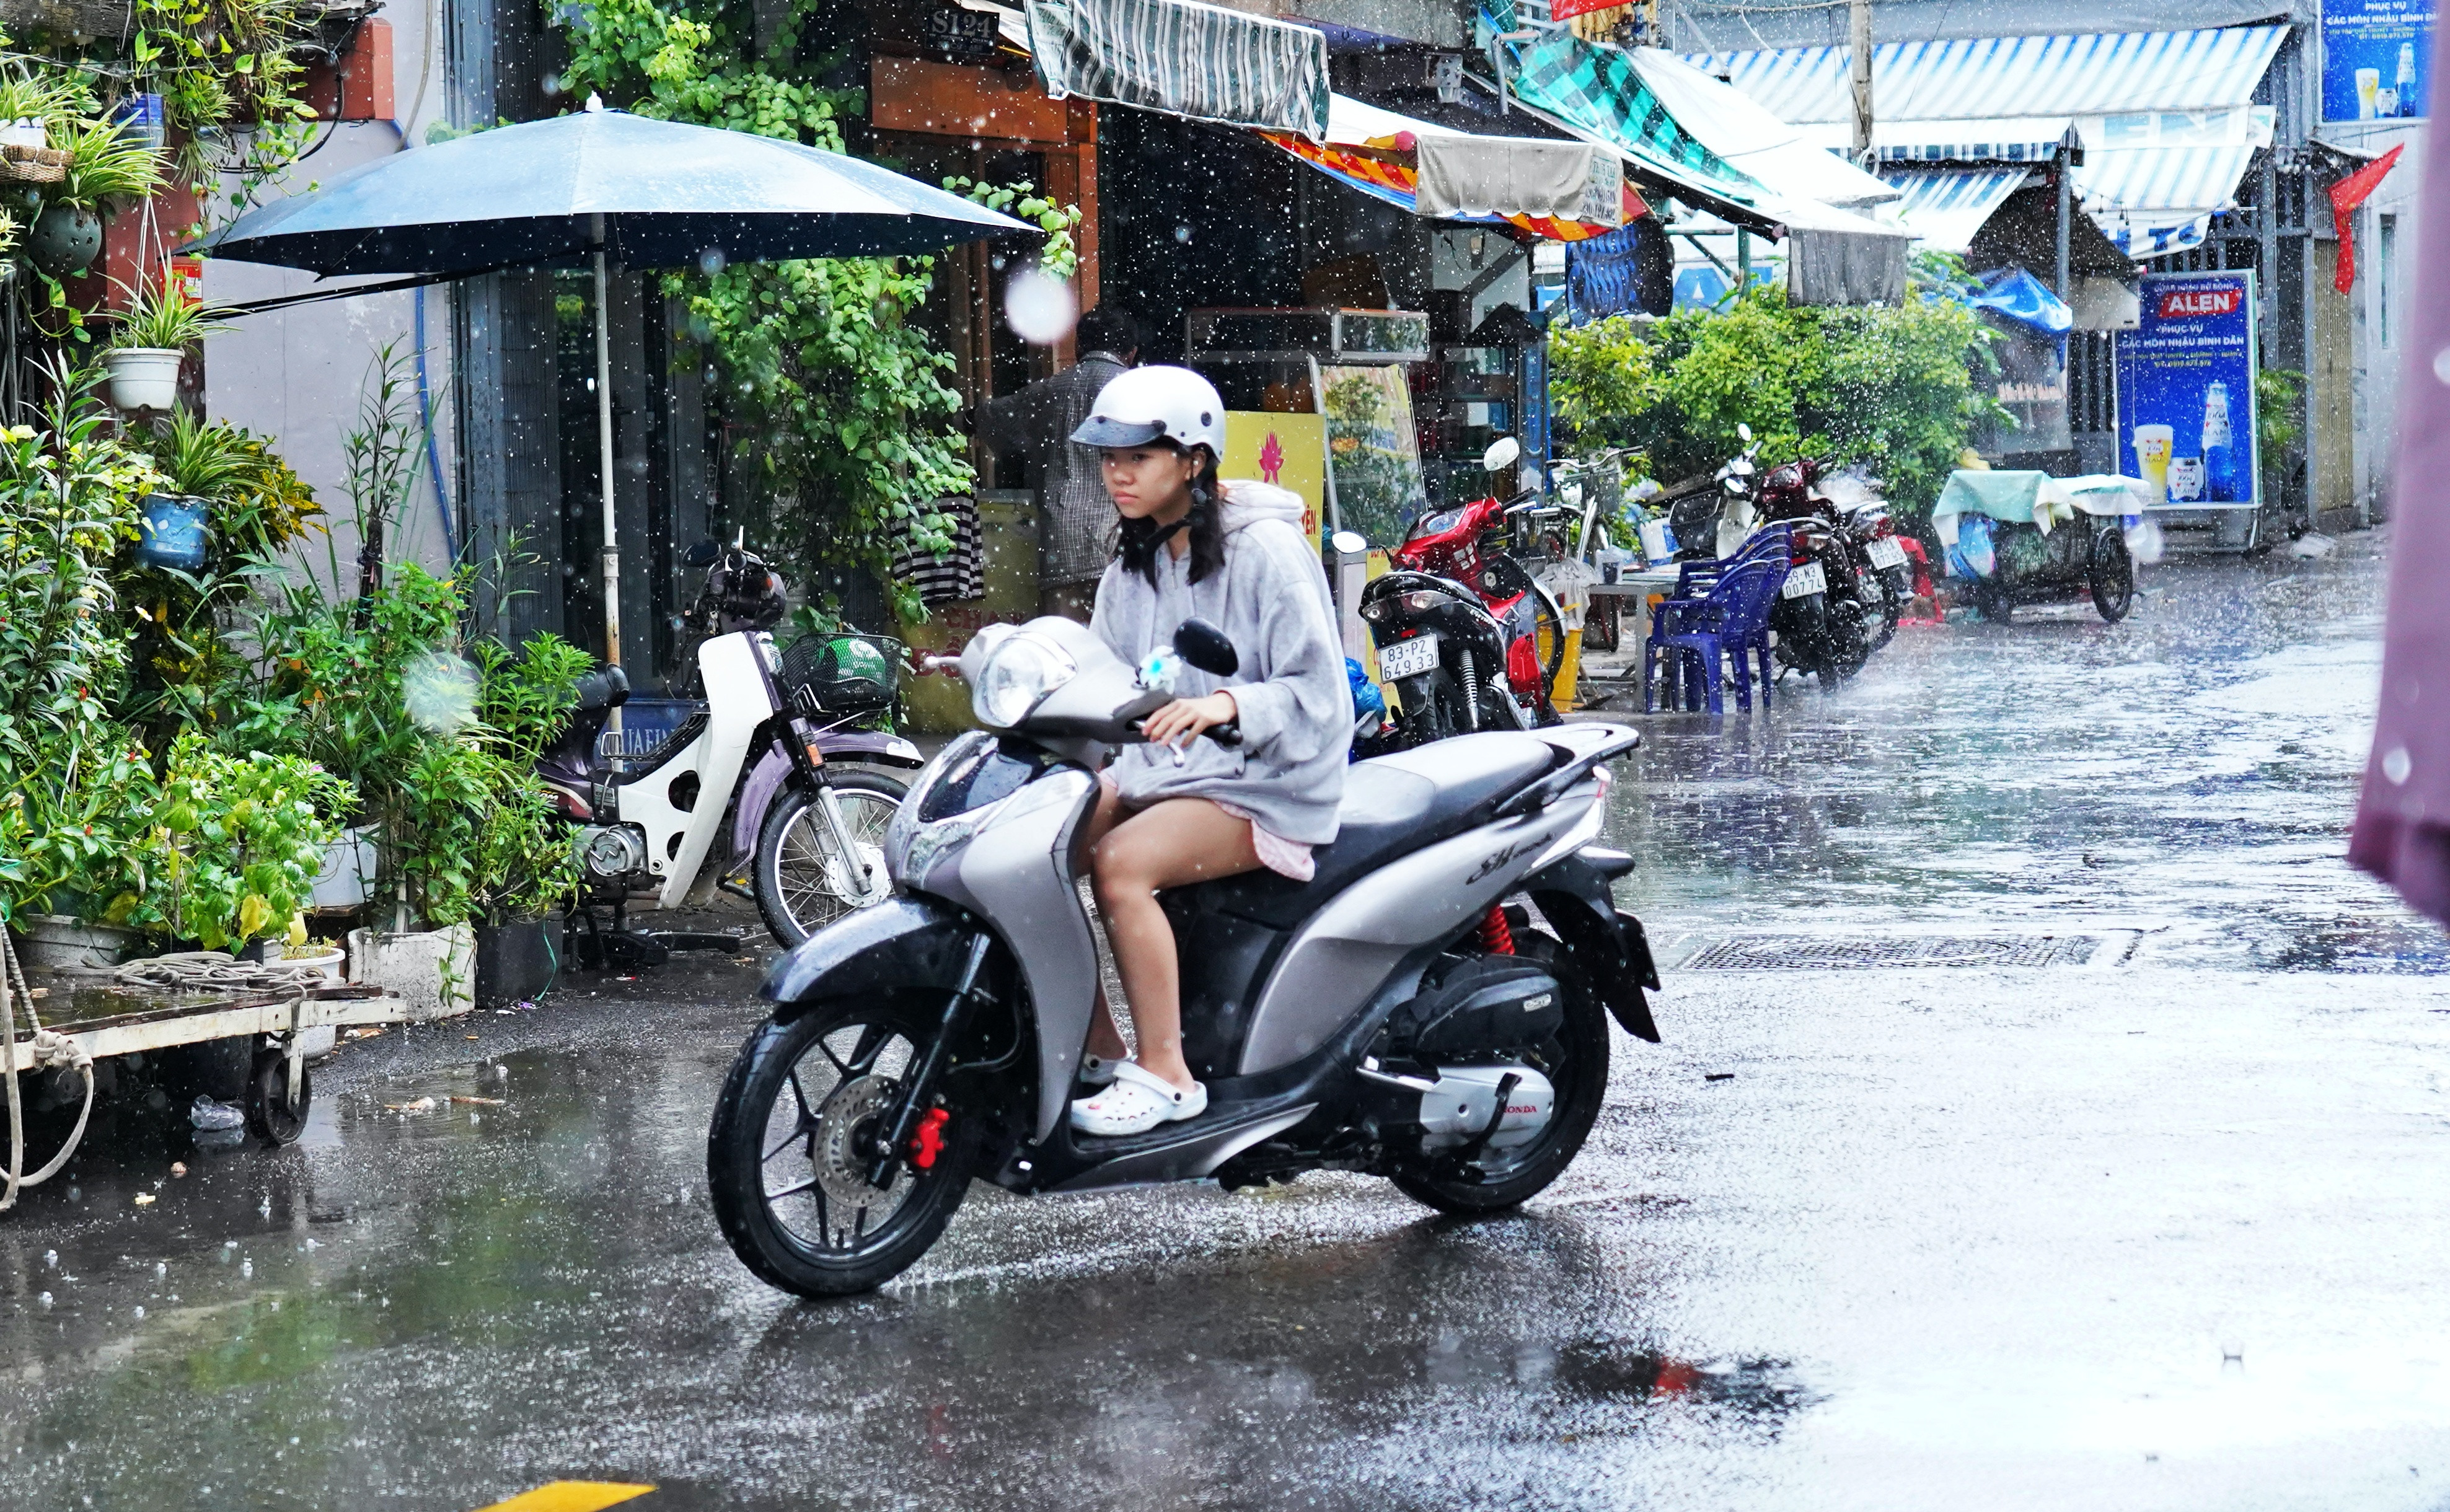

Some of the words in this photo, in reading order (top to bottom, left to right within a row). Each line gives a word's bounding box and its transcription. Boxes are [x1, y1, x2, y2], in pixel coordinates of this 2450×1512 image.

[2169, 293, 2229, 312] ALEN
[1388, 640, 1427, 662] 83-P2
[1383, 654, 1434, 680] 649.33
